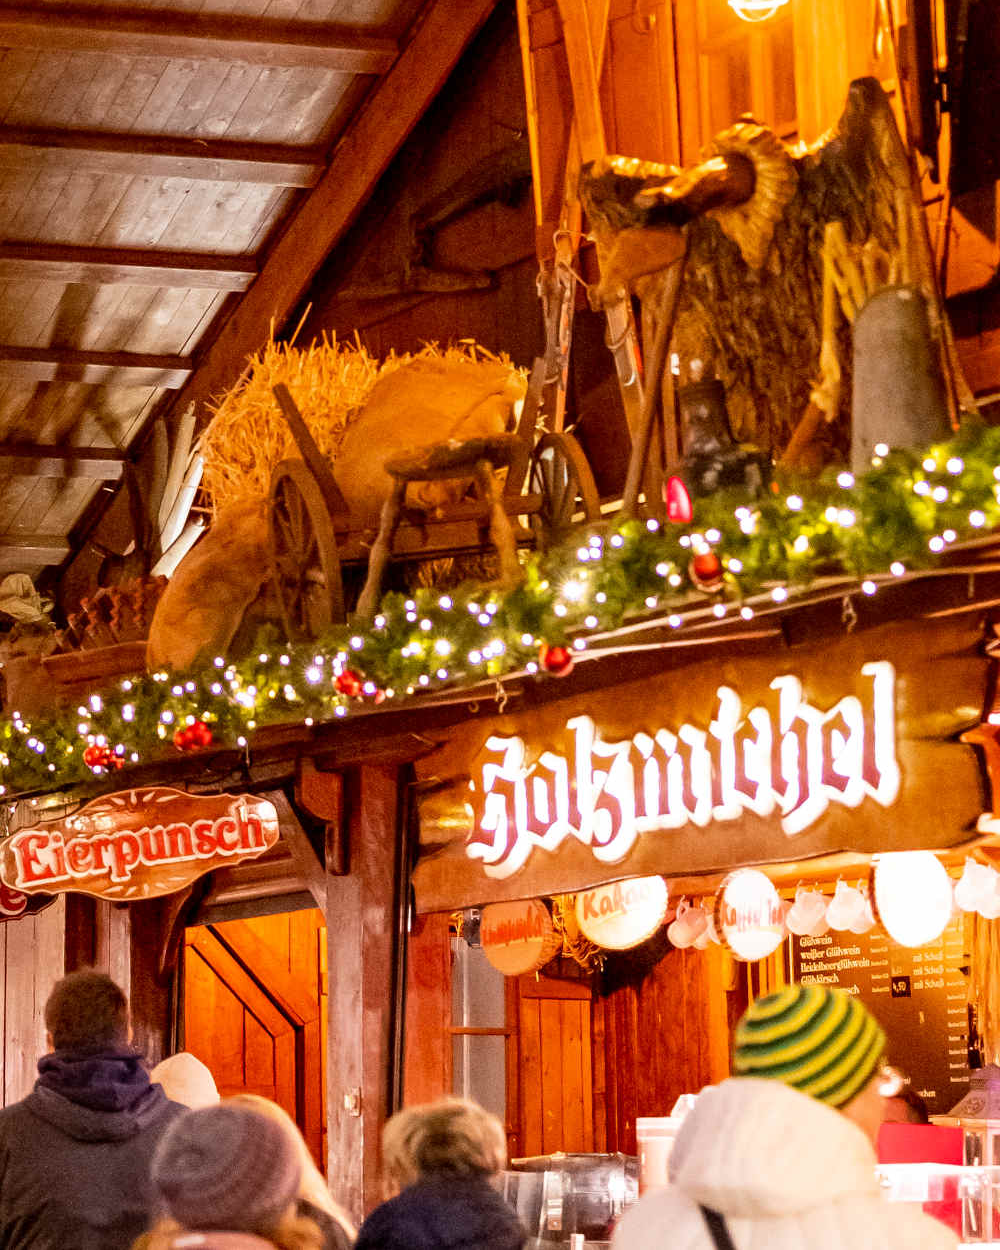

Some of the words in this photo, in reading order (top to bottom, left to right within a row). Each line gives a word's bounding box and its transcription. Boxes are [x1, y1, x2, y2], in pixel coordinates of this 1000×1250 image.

[465, 661, 900, 880] Holzmichel
[9, 797, 268, 883] Eierpunsch
[825, 944, 861, 958] Glühwein
